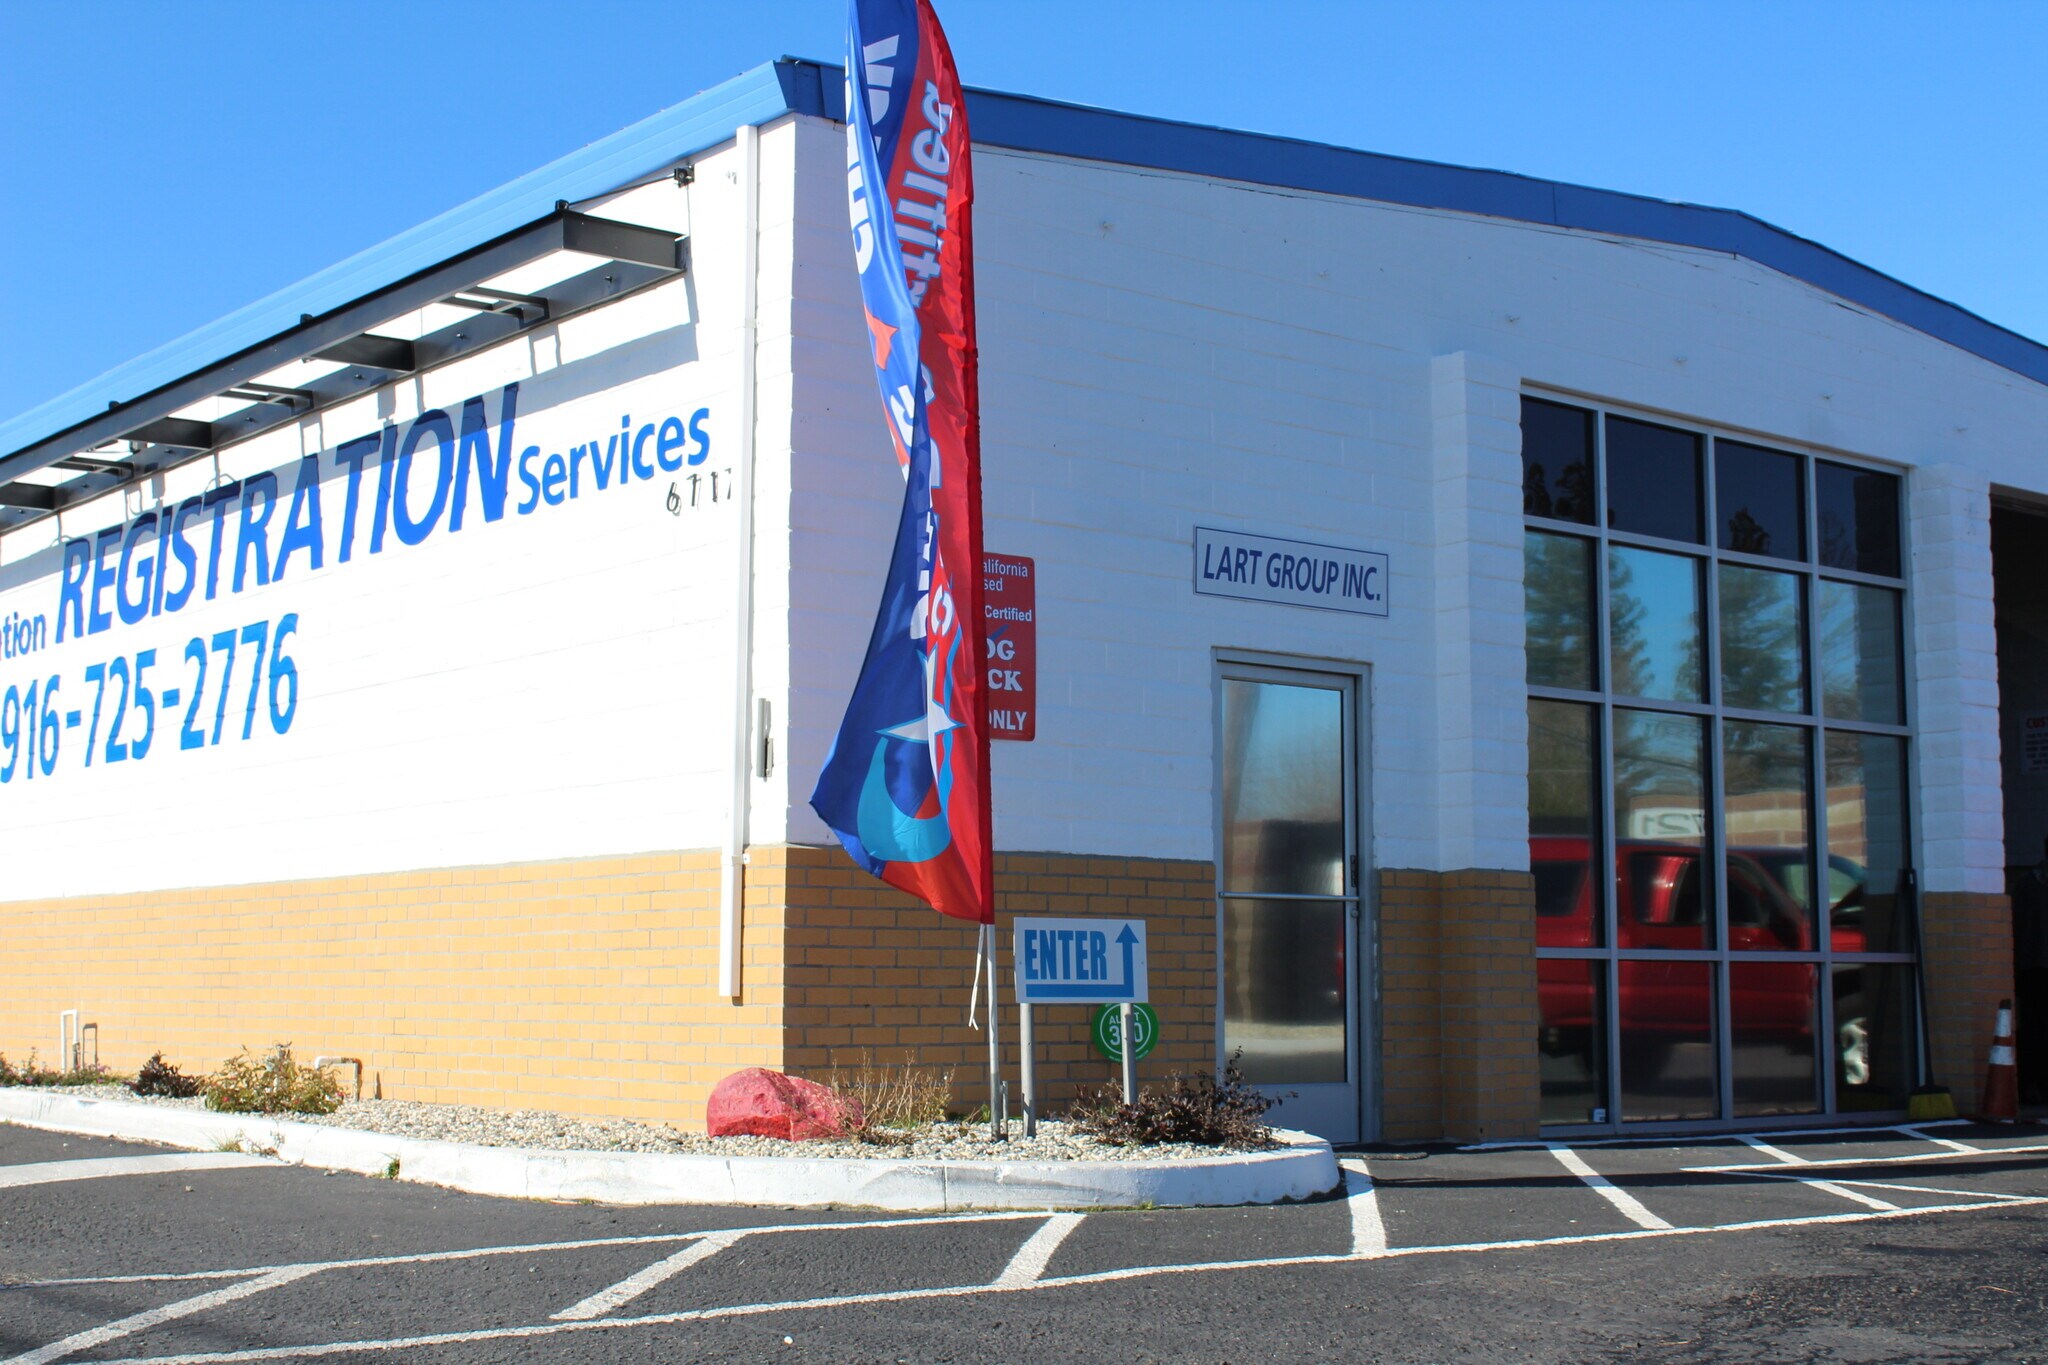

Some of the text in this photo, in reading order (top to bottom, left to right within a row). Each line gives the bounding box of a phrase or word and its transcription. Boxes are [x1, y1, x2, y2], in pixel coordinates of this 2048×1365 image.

[0, 383, 710, 661] tion REGISTRATION Services
[983, 559, 1028, 577] alifornia
[1203, 544, 1381, 601] LART GROUP INC.
[984, 578, 1003, 592] sed
[985, 605, 1032, 622] Certified
[988, 669, 1023, 692] CK
[0, 613, 299, 784] 916-725-2776
[989, 709, 1027, 732] NLY
[1024, 929, 1108, 980] ENTER
[1109, 1012, 1140, 1025] ALT
[1109, 1022, 1144, 1046] 30
